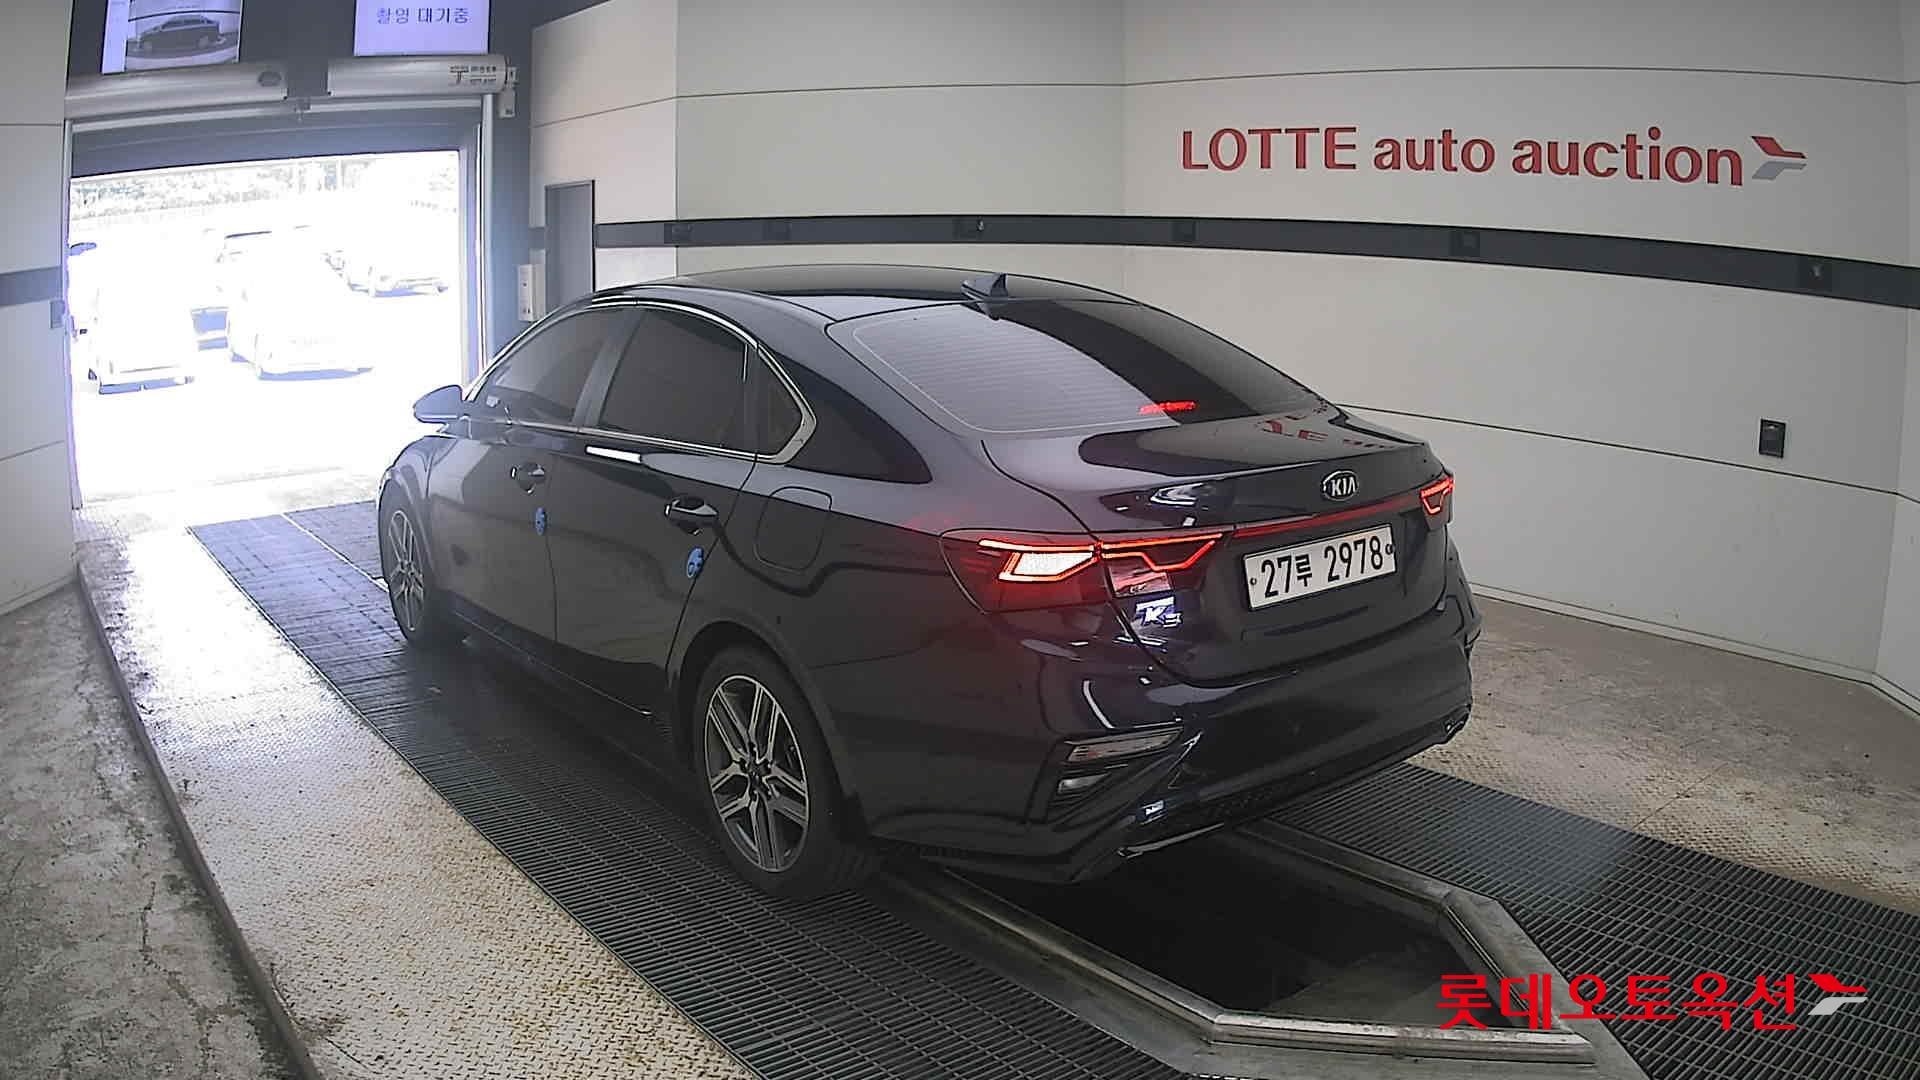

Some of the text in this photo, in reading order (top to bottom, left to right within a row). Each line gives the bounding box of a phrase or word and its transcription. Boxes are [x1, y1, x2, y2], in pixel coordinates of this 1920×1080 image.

[418, 7, 470, 24] 대기중
[1182, 126, 1743, 186] LOTTE auto auction
[1330, 476, 1357, 497] KIA
[1261, 535, 1384, 598] 27루 2978
